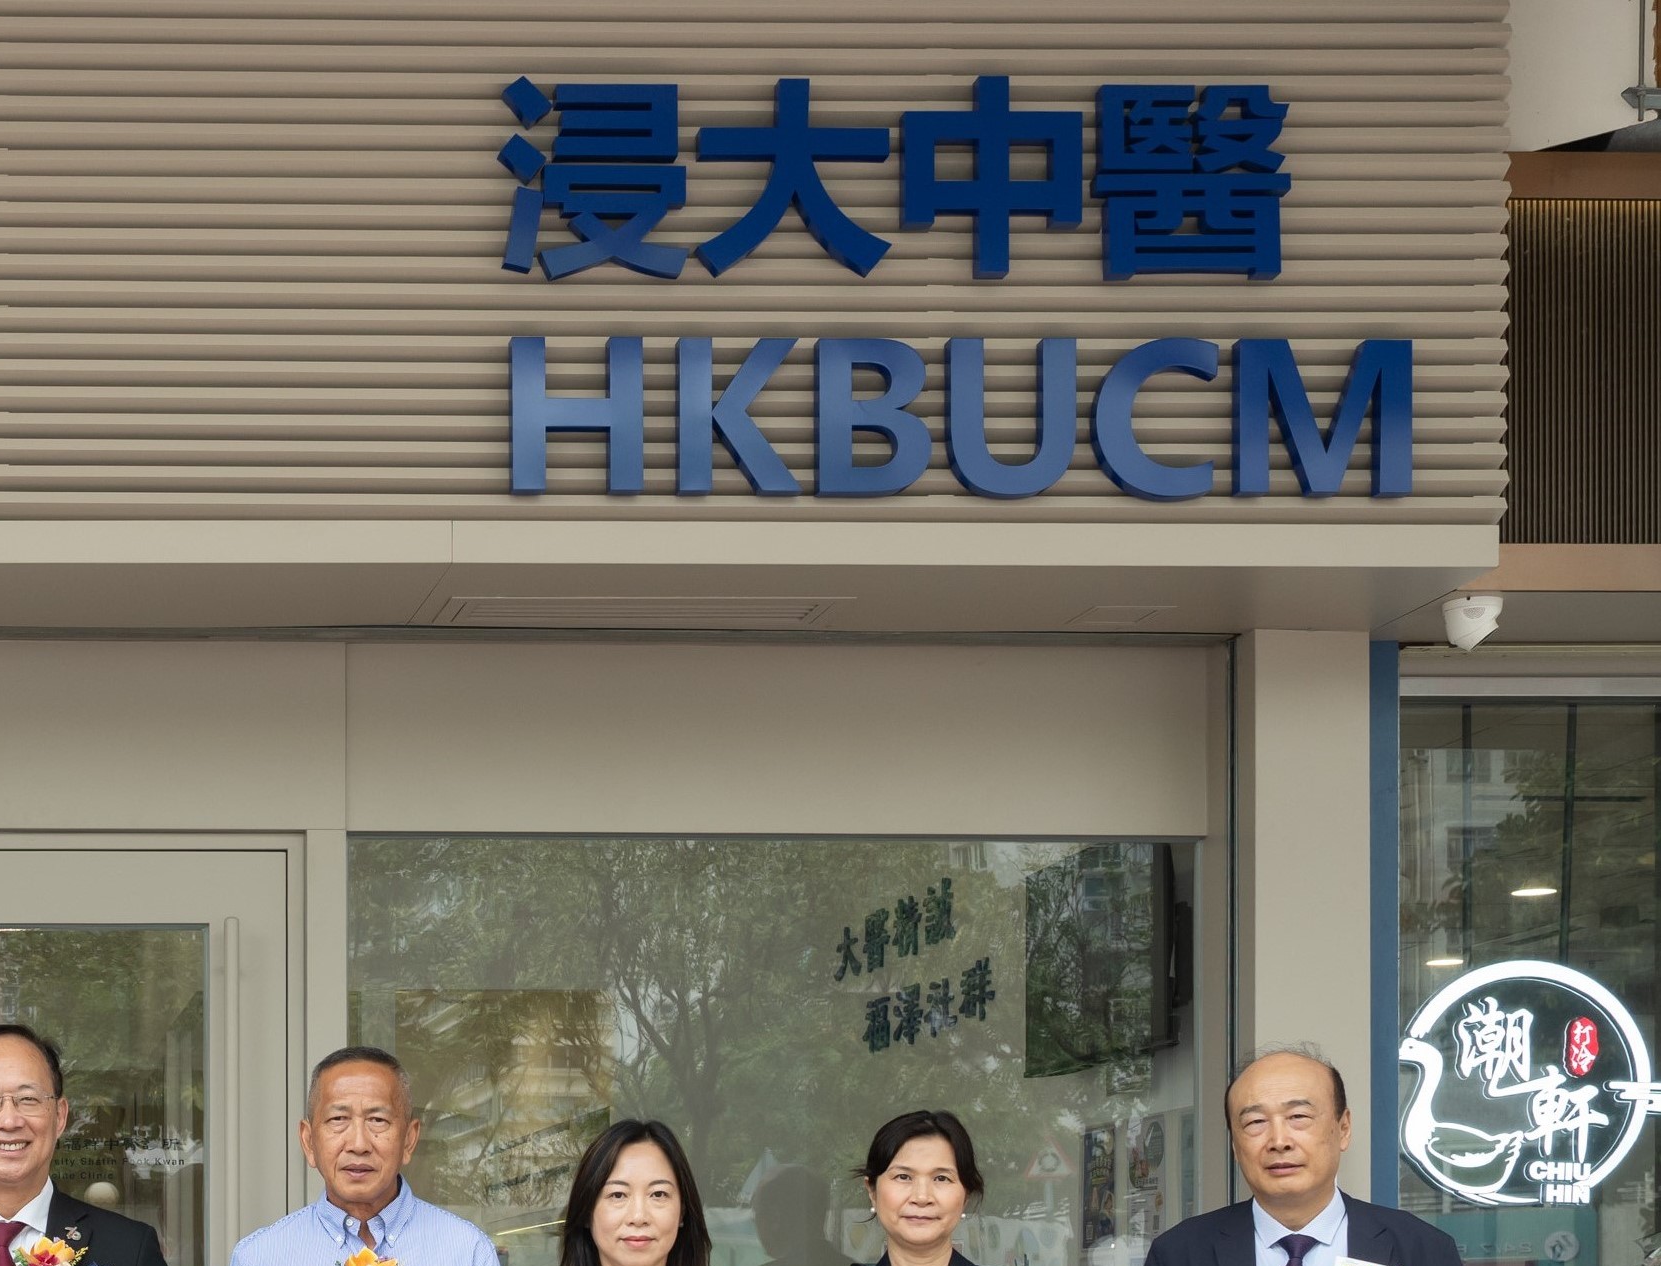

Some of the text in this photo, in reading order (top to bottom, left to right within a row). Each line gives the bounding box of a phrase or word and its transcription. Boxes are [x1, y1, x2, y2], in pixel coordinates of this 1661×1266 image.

[497, 75, 1292, 281] 浸大中醫
[507, 336, 1414, 502] HKBUCM
[80, 1156, 117, 1166] Shatin
[154, 1156, 185, 1166] Kwan
[1530, 1161, 1591, 1181] CHIU
[1546, 1183, 1591, 1204] HIN
